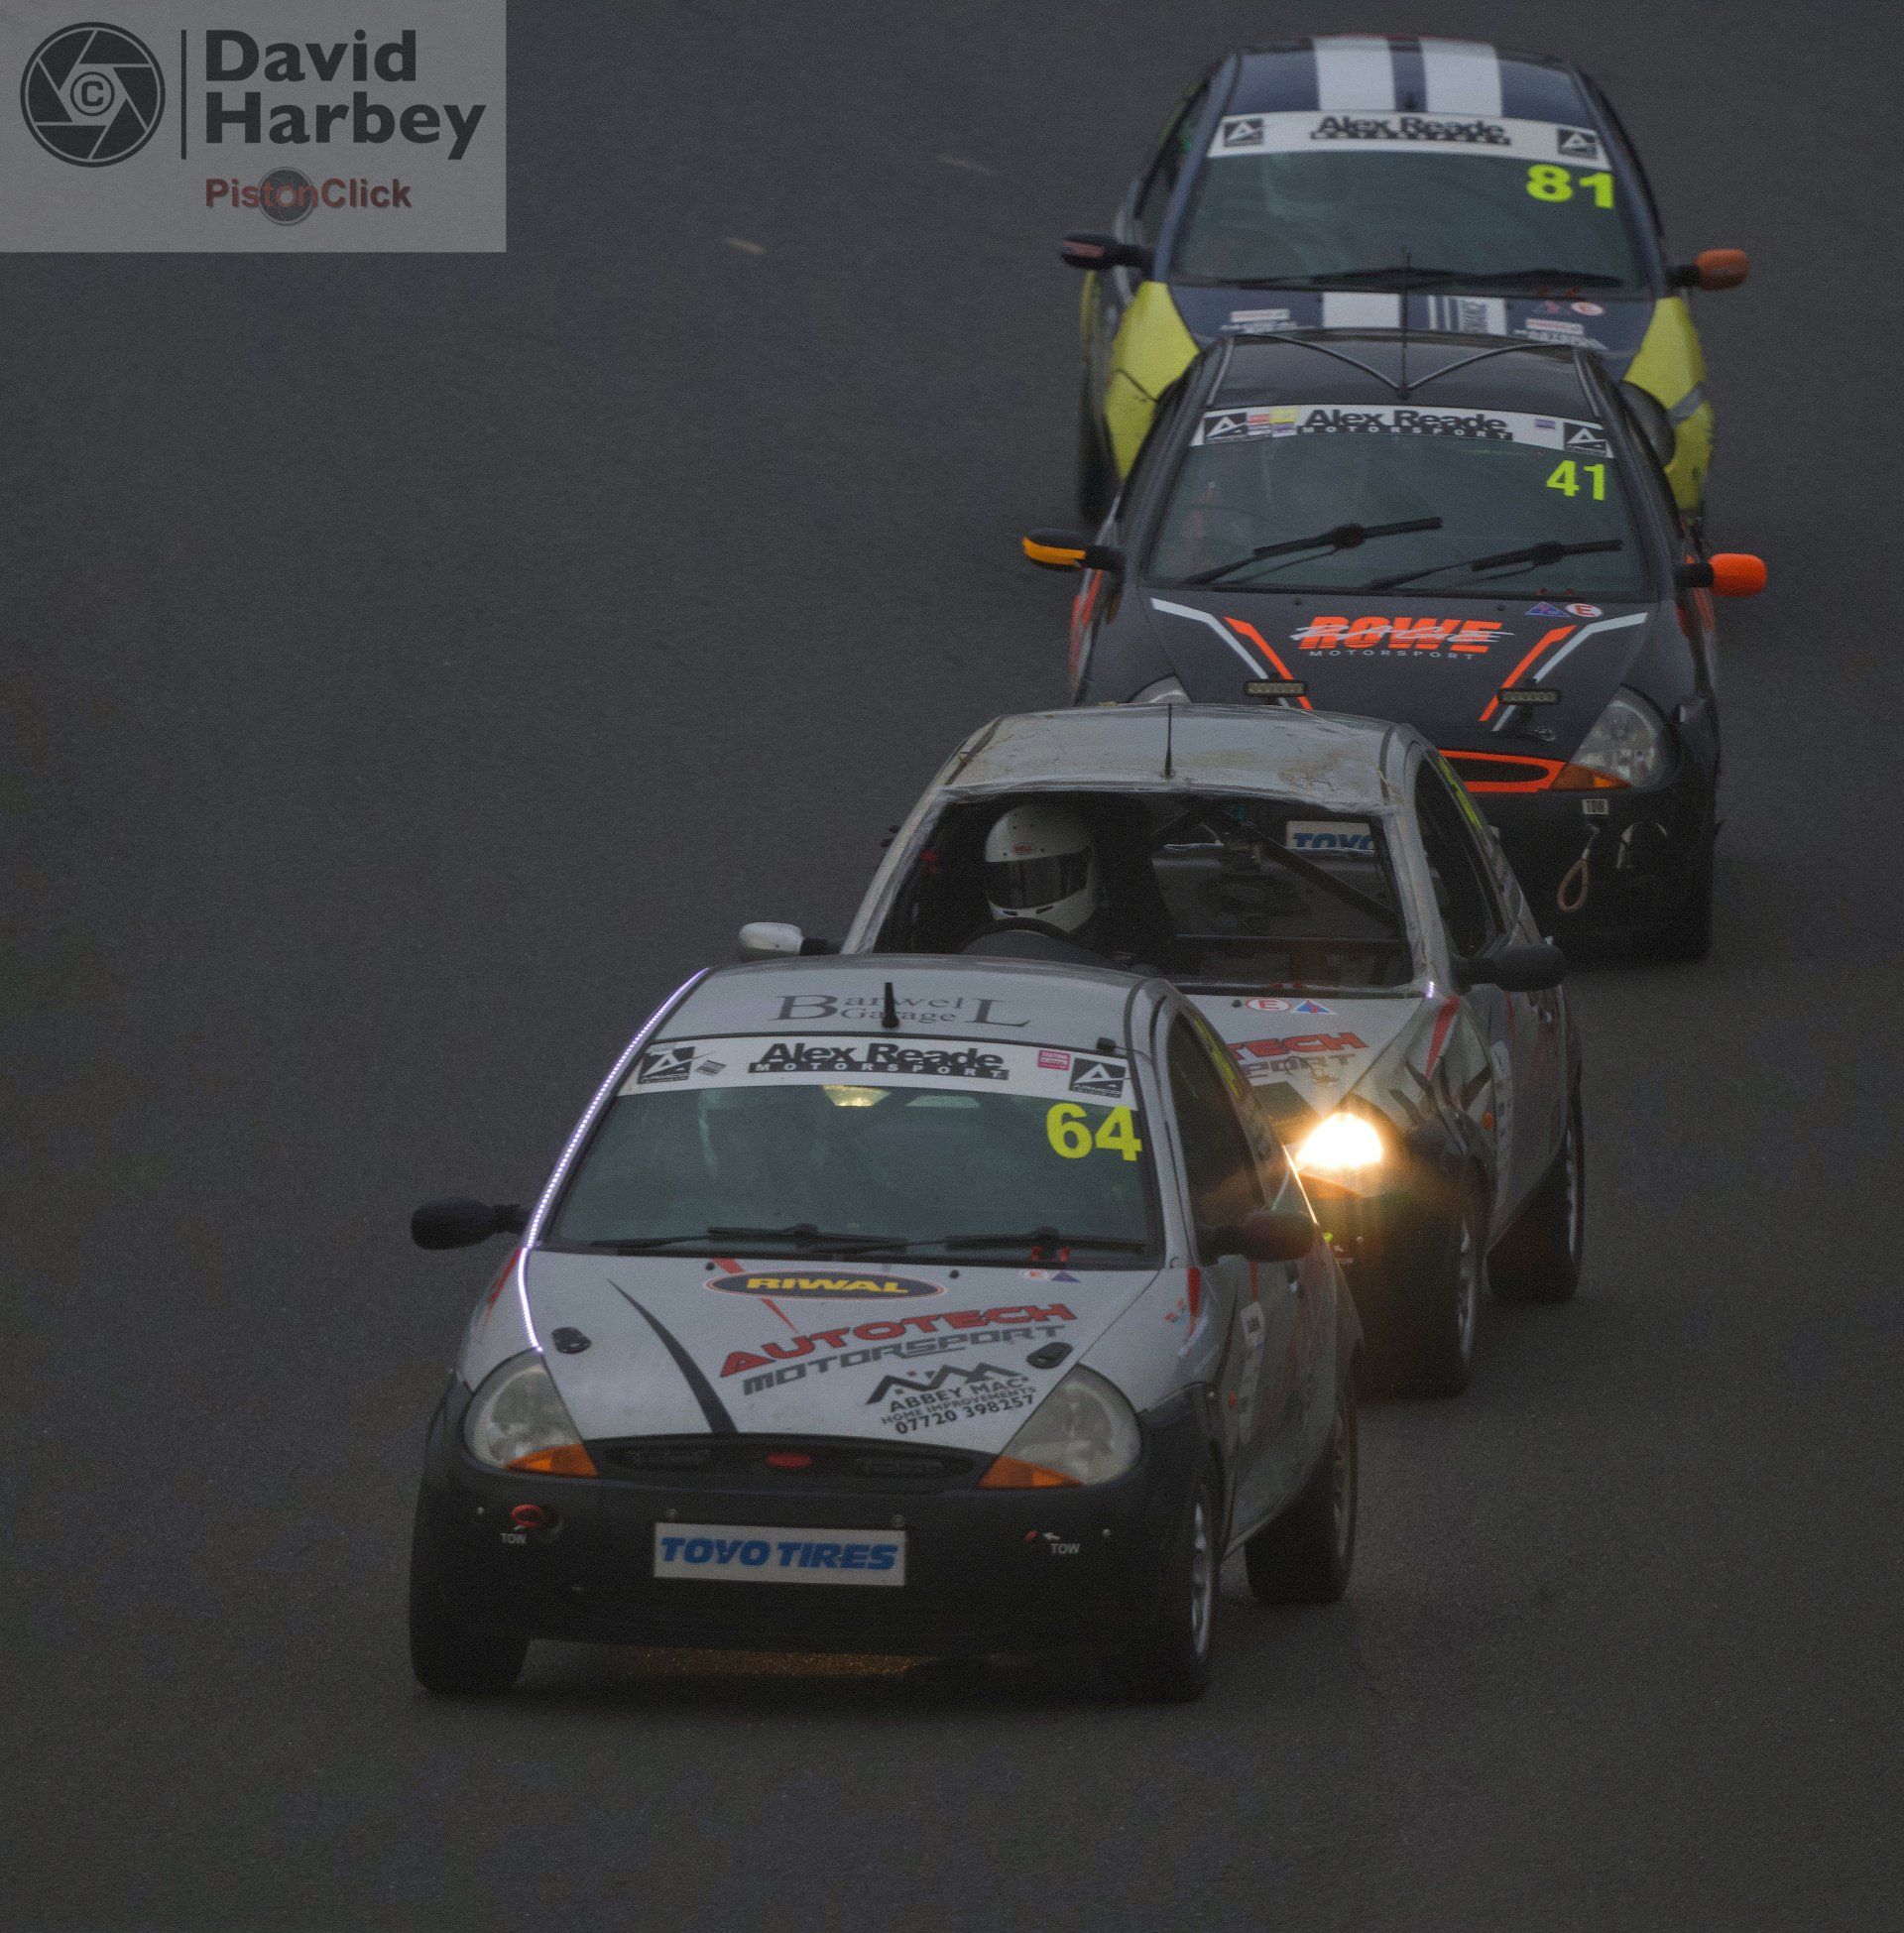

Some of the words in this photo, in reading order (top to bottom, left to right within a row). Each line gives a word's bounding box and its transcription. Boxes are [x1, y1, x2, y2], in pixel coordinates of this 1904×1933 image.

[1318, 115, 1391, 135] Alex
[1525, 163, 1614, 209] 81
[1301, 425, 1510, 440] MOTORSPORT
[1304, 409, 1386, 427] Alex
[1393, 409, 1507, 430] Reade
[1545, 459, 1606, 502] 41
[1298, 615, 1503, 654] ROWE
[1308, 649, 1475, 662] MOTORSPORT
[759, 1042, 859, 1064] Alex
[867, 1043, 1004, 1069] Reade
[753, 1061, 1005, 1078] MOTORSPORT
[1045, 1102, 1143, 1161] 64
[746, 1276, 909, 1295] RIWAL
[720, 1302, 1078, 1379] AUTOTECH
[742, 1324, 1066, 1396] MOTORSPORT
[881, 1408, 923, 1425] HOME
[926, 1386, 1037, 1414] IMPROVEMENTS
[890, 1387, 962, 1413] ABBEY
[894, 1408, 959, 1435] 07720
[962, 1393, 1034, 1419] 398257
[500, 1532, 528, 1545] TOW
[1050, 1542, 1081, 1555] TOW
[660, 1535, 771, 1566] TOYO
[776, 1539, 899, 1571] TIRES
